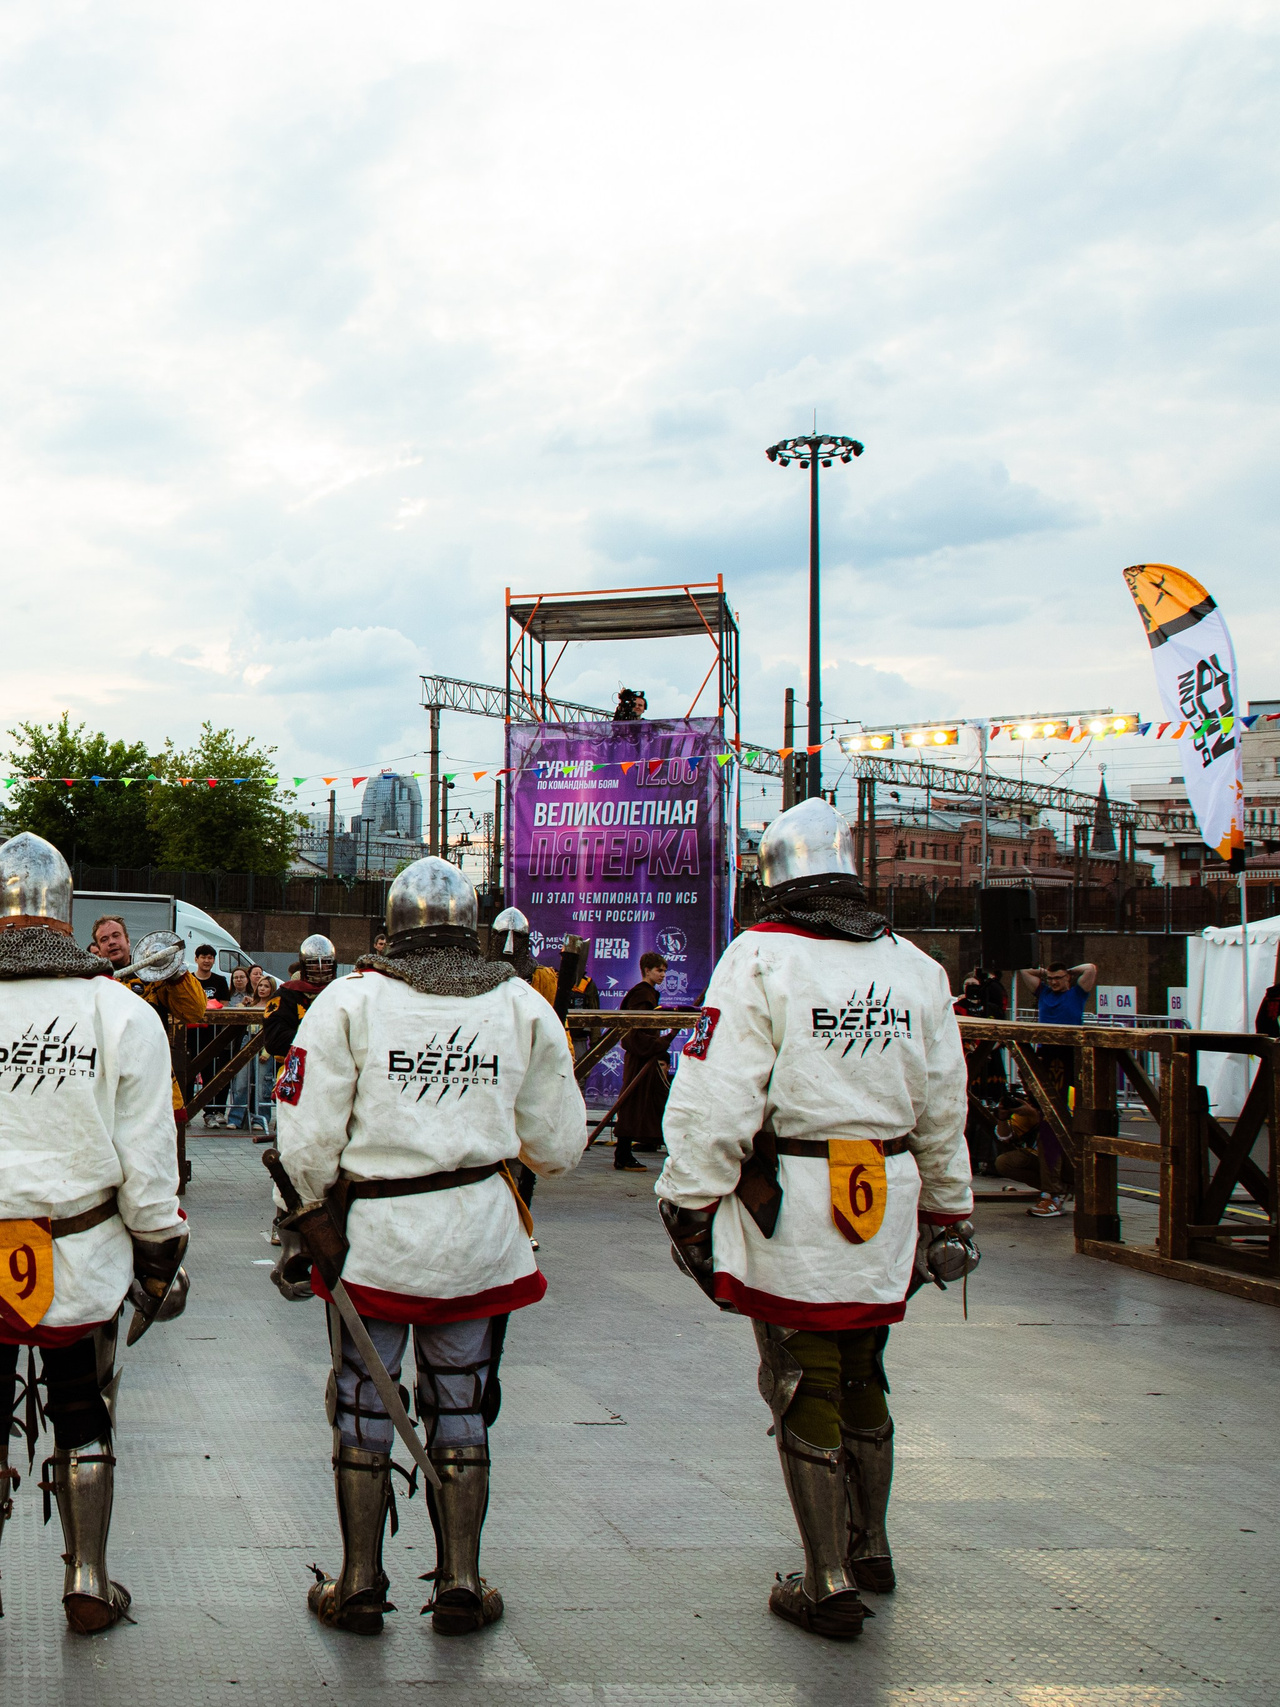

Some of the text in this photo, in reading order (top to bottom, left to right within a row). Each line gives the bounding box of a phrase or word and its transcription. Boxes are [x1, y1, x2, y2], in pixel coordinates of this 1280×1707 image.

[537, 760, 594, 778] ТУРНИР
[635, 757, 699, 786] 12.06
[537, 780, 620, 790] ПО КОМАНДНЫМ БОЯМ
[533, 799, 698, 827] ВЕЛИКОЛЕПНАЯ
[528, 829, 700, 877] ПЯТЕРКА
[531, 892, 698, 904] III ЭТАП ЧЕМПИОНАТА ПО ИСБ
[572, 910, 656, 922] «МЕЧ РОССИИ»
[595, 938, 630, 949] ПУТЬ
[1099, 994, 1108, 1007] 6A
[1116, 994, 1131, 1008] 6A
[22, 1034, 60, 1042] КЛУБ
[812, 1031, 912, 1039] ЕДИНОБОРСТВ
[426, 1044, 463, 1052] КЛУБ
[387, 1073, 498, 1085] ЕДИНОБОРСТВ
[849, 1164, 873, 1218] 6
[9, 1243, 37, 1300] 9
